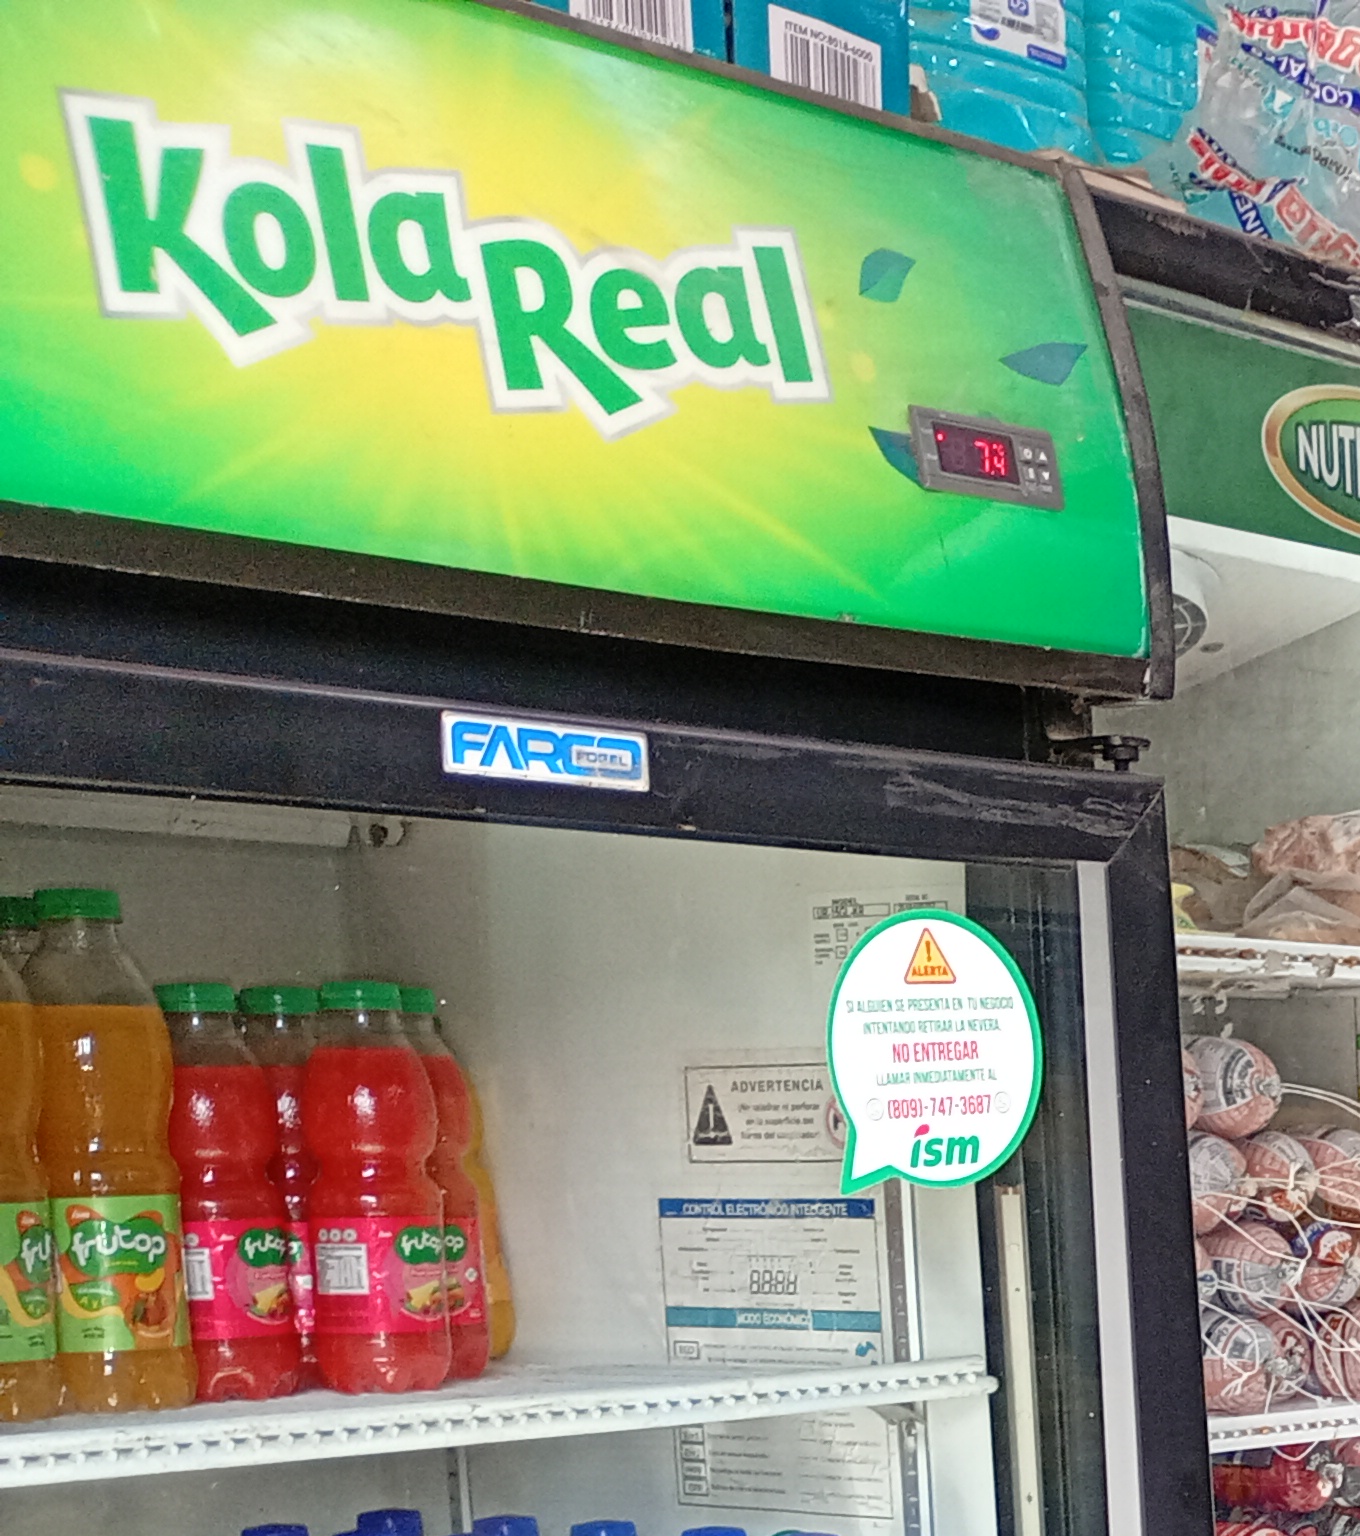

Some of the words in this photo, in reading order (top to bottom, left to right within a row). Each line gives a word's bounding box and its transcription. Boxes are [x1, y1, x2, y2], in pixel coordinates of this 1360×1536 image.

[783, 20, 808, 36] ITEM
[86, 114, 471, 340] Kola
[479, 238, 815, 416] Real
[451, 720, 641, 781] FARCO
[911, 964, 949, 977] ALERTA
[857, 999, 893, 1013] ALGUIEN
[895, 998, 905, 1012] SE
[907, 997, 950, 1012] PRESENTA
[952, 997, 963, 1010] EN
[967, 996, 978, 1010] TU
[980, 996, 1014, 1010] NEGOCIO
[863, 1020, 916, 1035] INTENTANDO
[918, 1019, 953, 1033] RETIRAR
[955, 1019, 966, 1032] LA
[892, 1042, 910, 1064] NO
[913, 1040, 979, 1063] ENTREGAR
[730, 1078, 824, 1093] ADVERTENCIA
[876, 1070, 911, 1086] LLAMAR
[913, 1068, 985, 1085] INMEDIATAMENTE
[987, 1067, 997, 1081] AL
[887, 1094, 992, 1120] (809)-747-3687
[910, 1123, 980, 1169] ism
[71, 1223, 166, 1267] frutop
